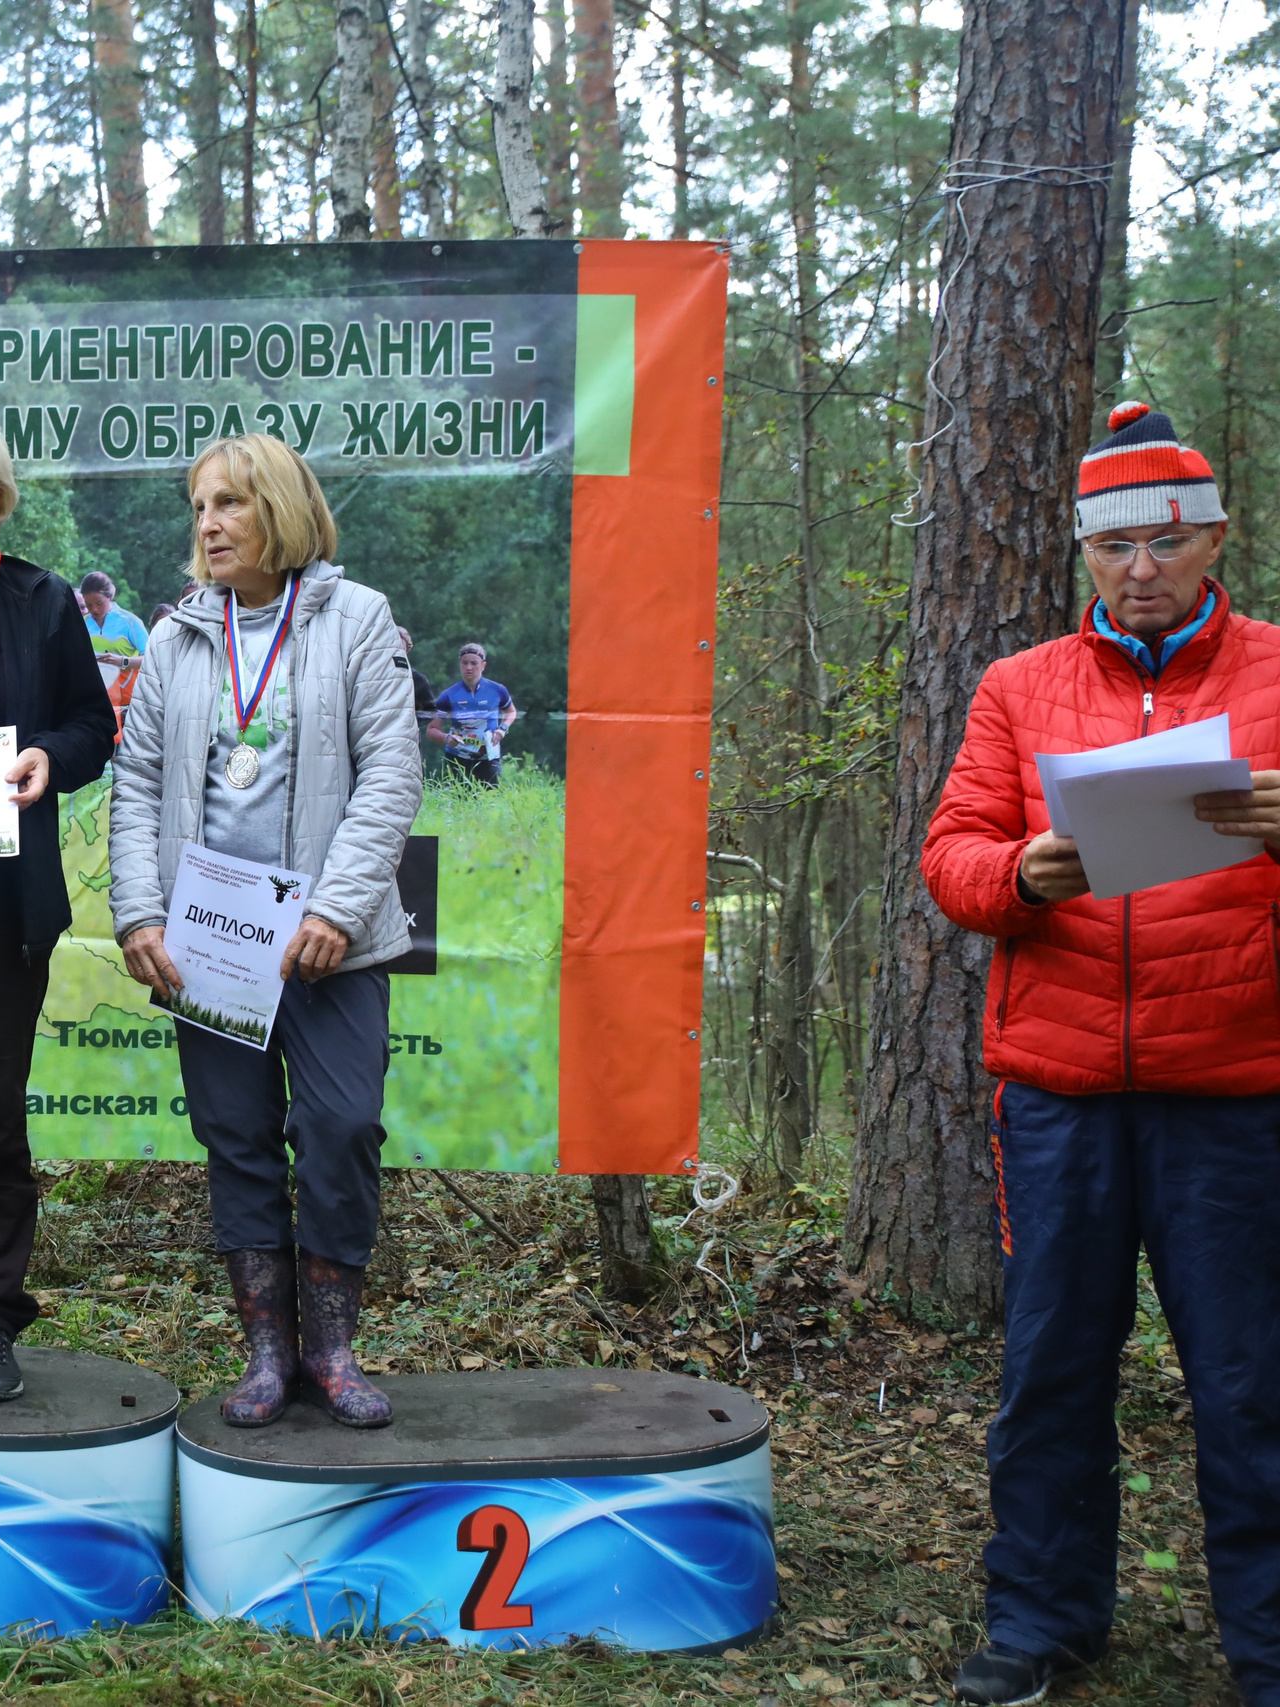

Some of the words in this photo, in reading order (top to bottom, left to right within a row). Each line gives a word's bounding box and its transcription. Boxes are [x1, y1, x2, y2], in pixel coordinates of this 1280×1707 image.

[341, 400, 546, 458] ЖИЗНИ
[234, 755, 249, 776] 2
[184, 904, 275, 946] ДИПЛОМ
[52, 1021, 179, 1049] Тюмен
[26, 1095, 158, 1116] анская
[456, 1504, 533, 1632] 2
